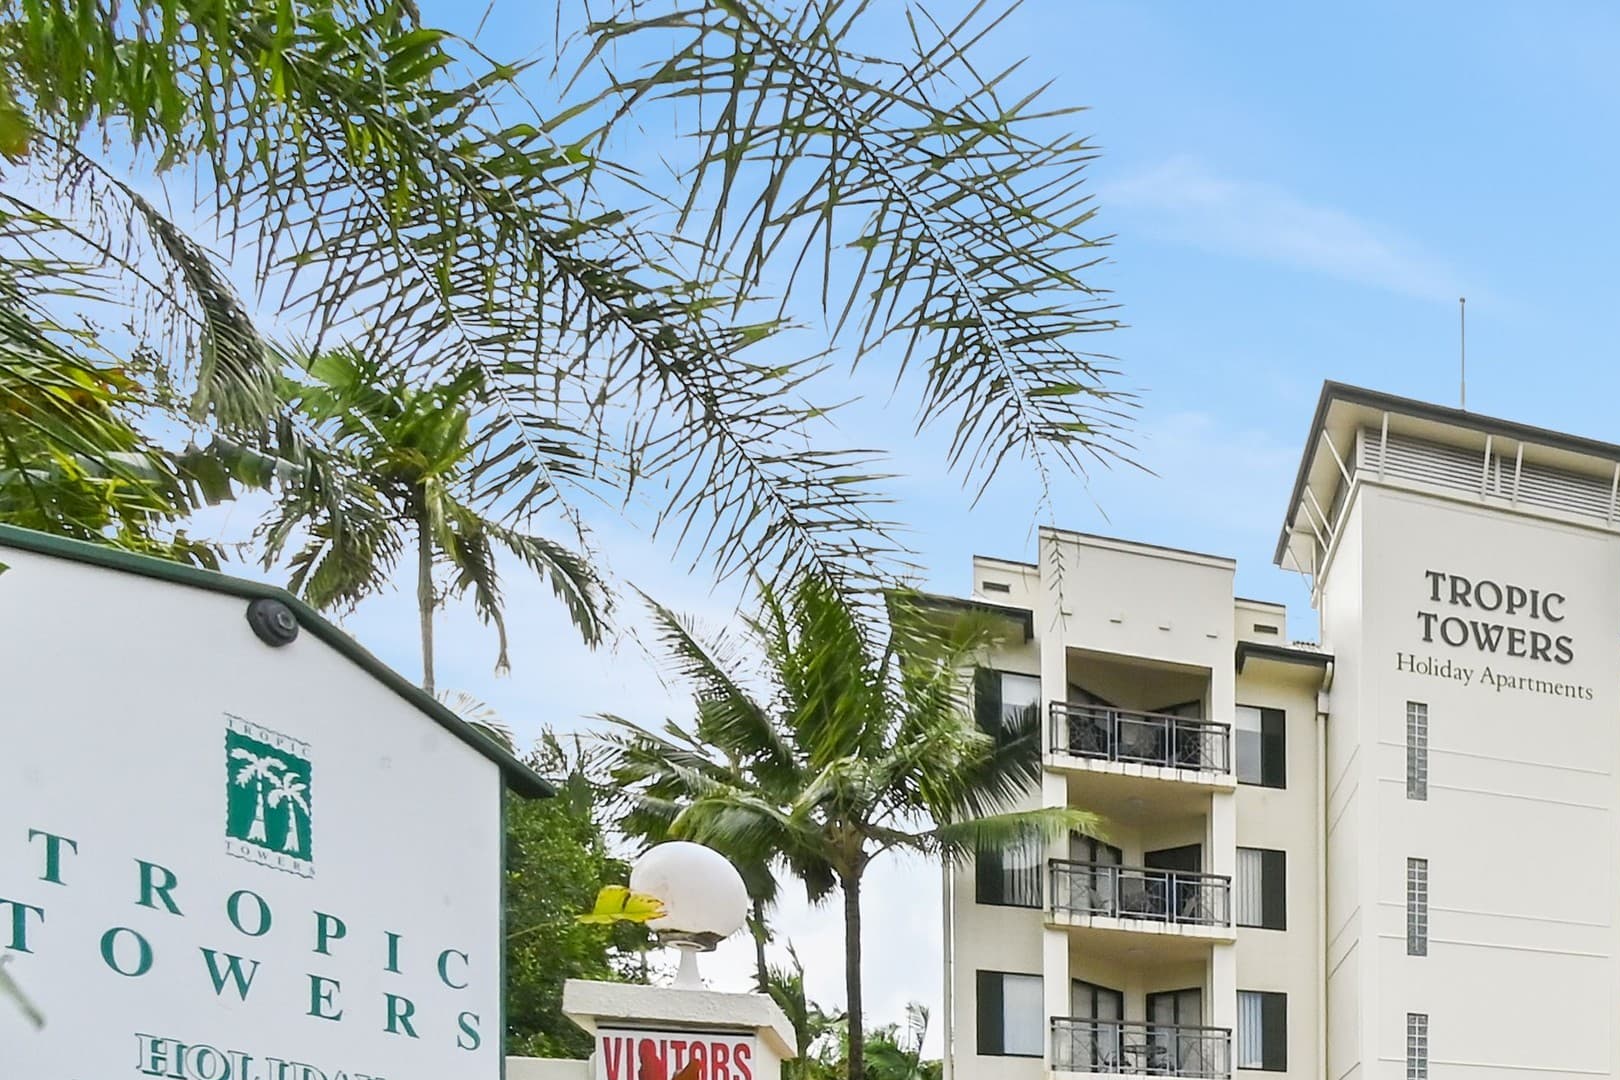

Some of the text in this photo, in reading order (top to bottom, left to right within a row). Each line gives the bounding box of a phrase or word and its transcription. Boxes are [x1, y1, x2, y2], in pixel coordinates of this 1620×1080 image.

[1425, 569, 1566, 623] TROPIC
[1416, 610, 1574, 665] TOWERS
[1395, 652, 1594, 700] Holiday Apartments
[28, 828, 470, 990] TROPIC
[0, 898, 482, 1051] TOWERS
